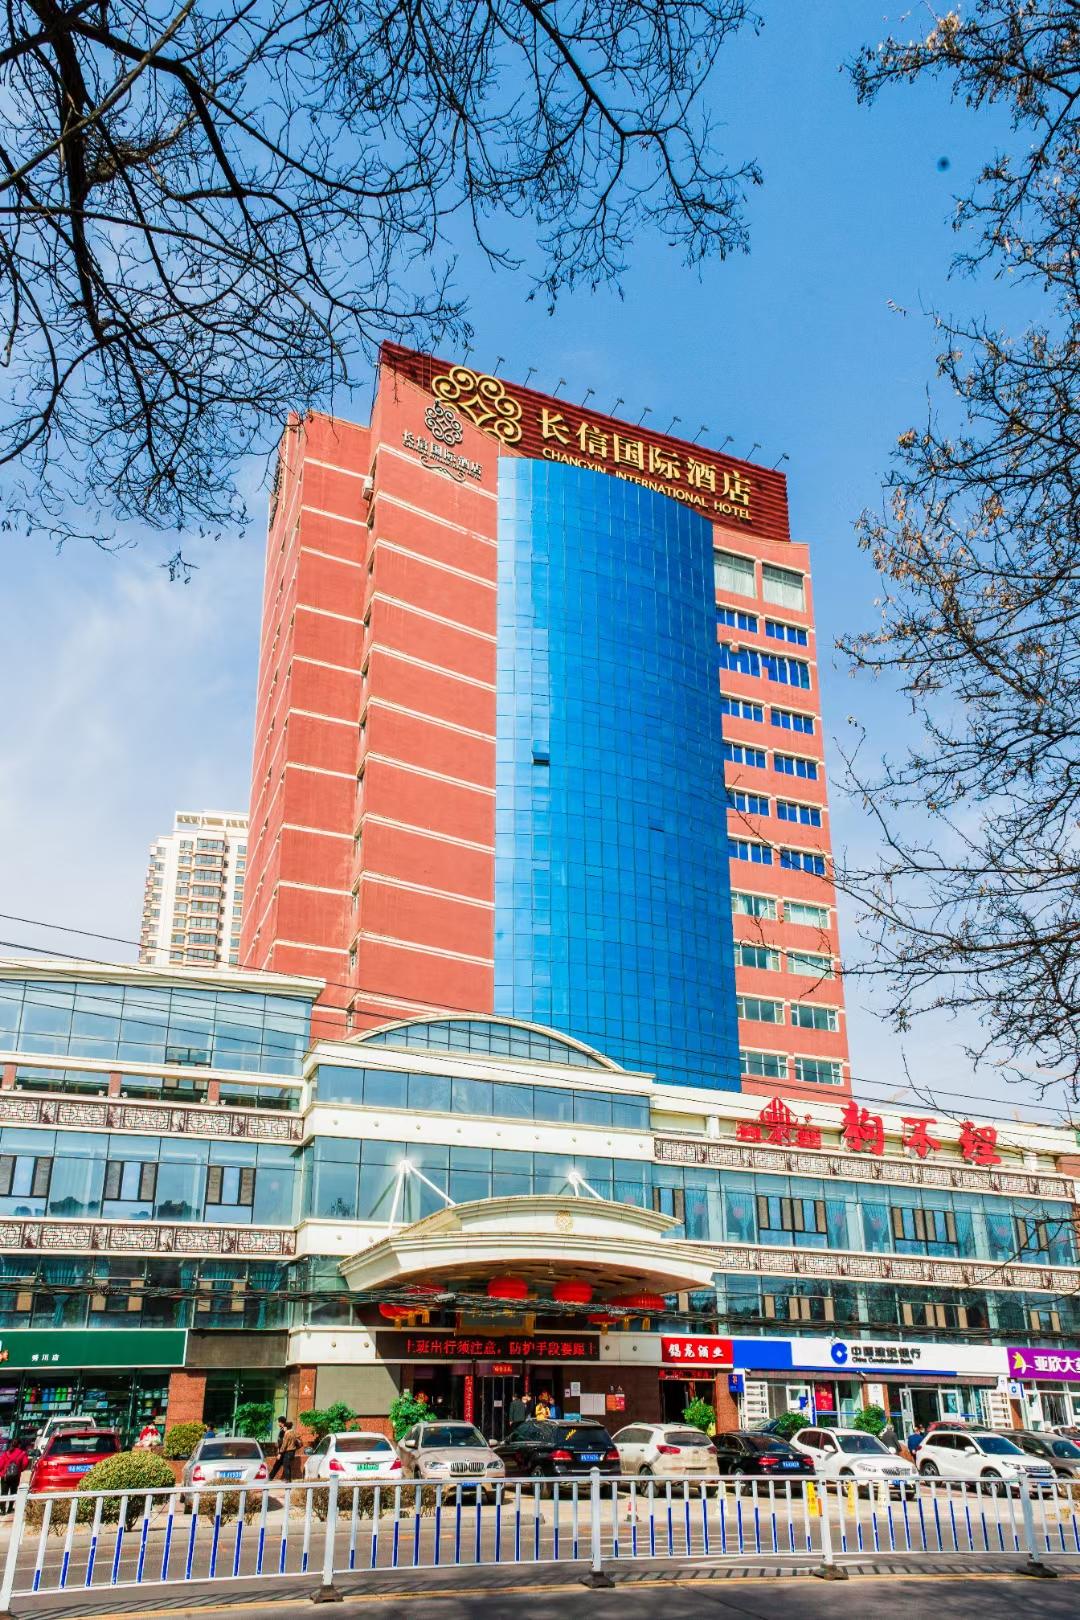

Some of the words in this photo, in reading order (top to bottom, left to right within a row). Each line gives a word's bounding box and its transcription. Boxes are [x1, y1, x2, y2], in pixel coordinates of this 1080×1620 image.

[537, 408, 752, 506] 长信国际酒店
[542, 447, 607, 475] CHANGXIN
[615, 470, 709, 507] INTERNATIONAL
[713, 500, 752, 520] HOTEL
